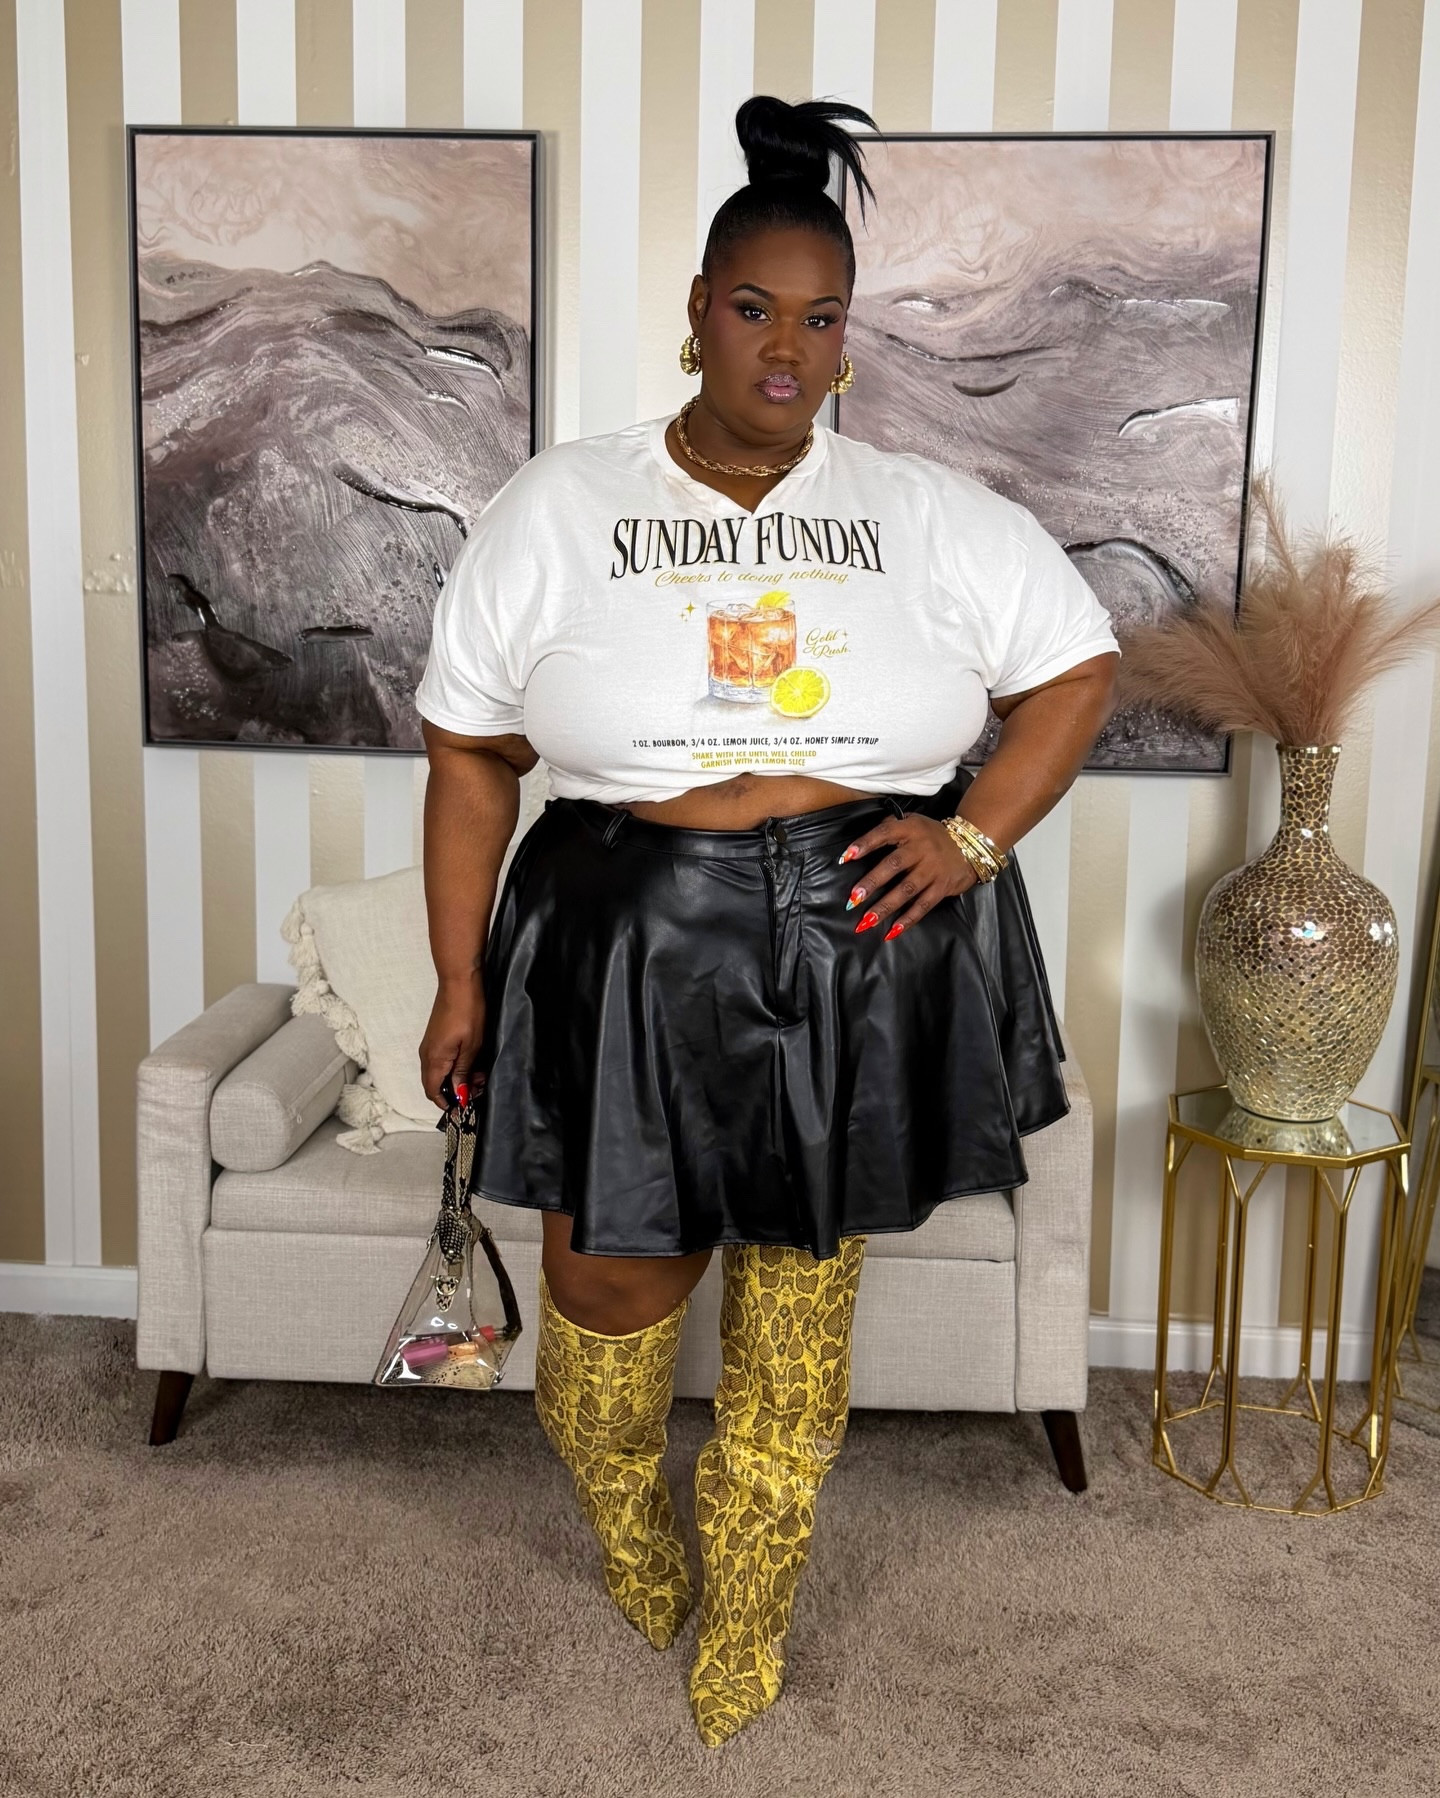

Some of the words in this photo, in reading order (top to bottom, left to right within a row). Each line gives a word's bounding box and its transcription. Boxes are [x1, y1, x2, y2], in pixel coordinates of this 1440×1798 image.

[610, 516, 748, 580] SUNDAY
[755, 511, 886, 575] FUNDAY
[654, 570, 712, 588] Cheers
[717, 570, 733, 582] to
[738, 572, 784, 585] doing
[789, 568, 849, 584] nothing.
[802, 627, 841, 654] Gold
[632, 740, 637, 748] 2
[639, 739, 651, 748] OZ.
[652, 739, 689, 748] BOURBON,
[691, 738, 705, 748] 3/4
[707, 738, 720, 746] OZ.
[723, 737, 747, 746] LEMON
[749, 737, 771, 747] JUICE,
[773, 737, 787, 747] 3/4
[790, 737, 803, 745] OZ.
[805, 736, 829, 745] HONEY
[831, 736, 856, 745] SIMPLE
[857, 736, 879, 745] SYRUP
[691, 752, 713, 760] SHAKE
[715, 751, 734, 759] WITH
[749, 750, 769, 758] UNTIL
[771, 750, 788, 758] WELL
[790, 750, 817, 758] CHILLED
[701, 759, 732, 769] GARNISH
[734, 758, 753, 766] WITH
[762, 757, 786, 765] LEMON
[788, 758, 806, 766] SLICE
